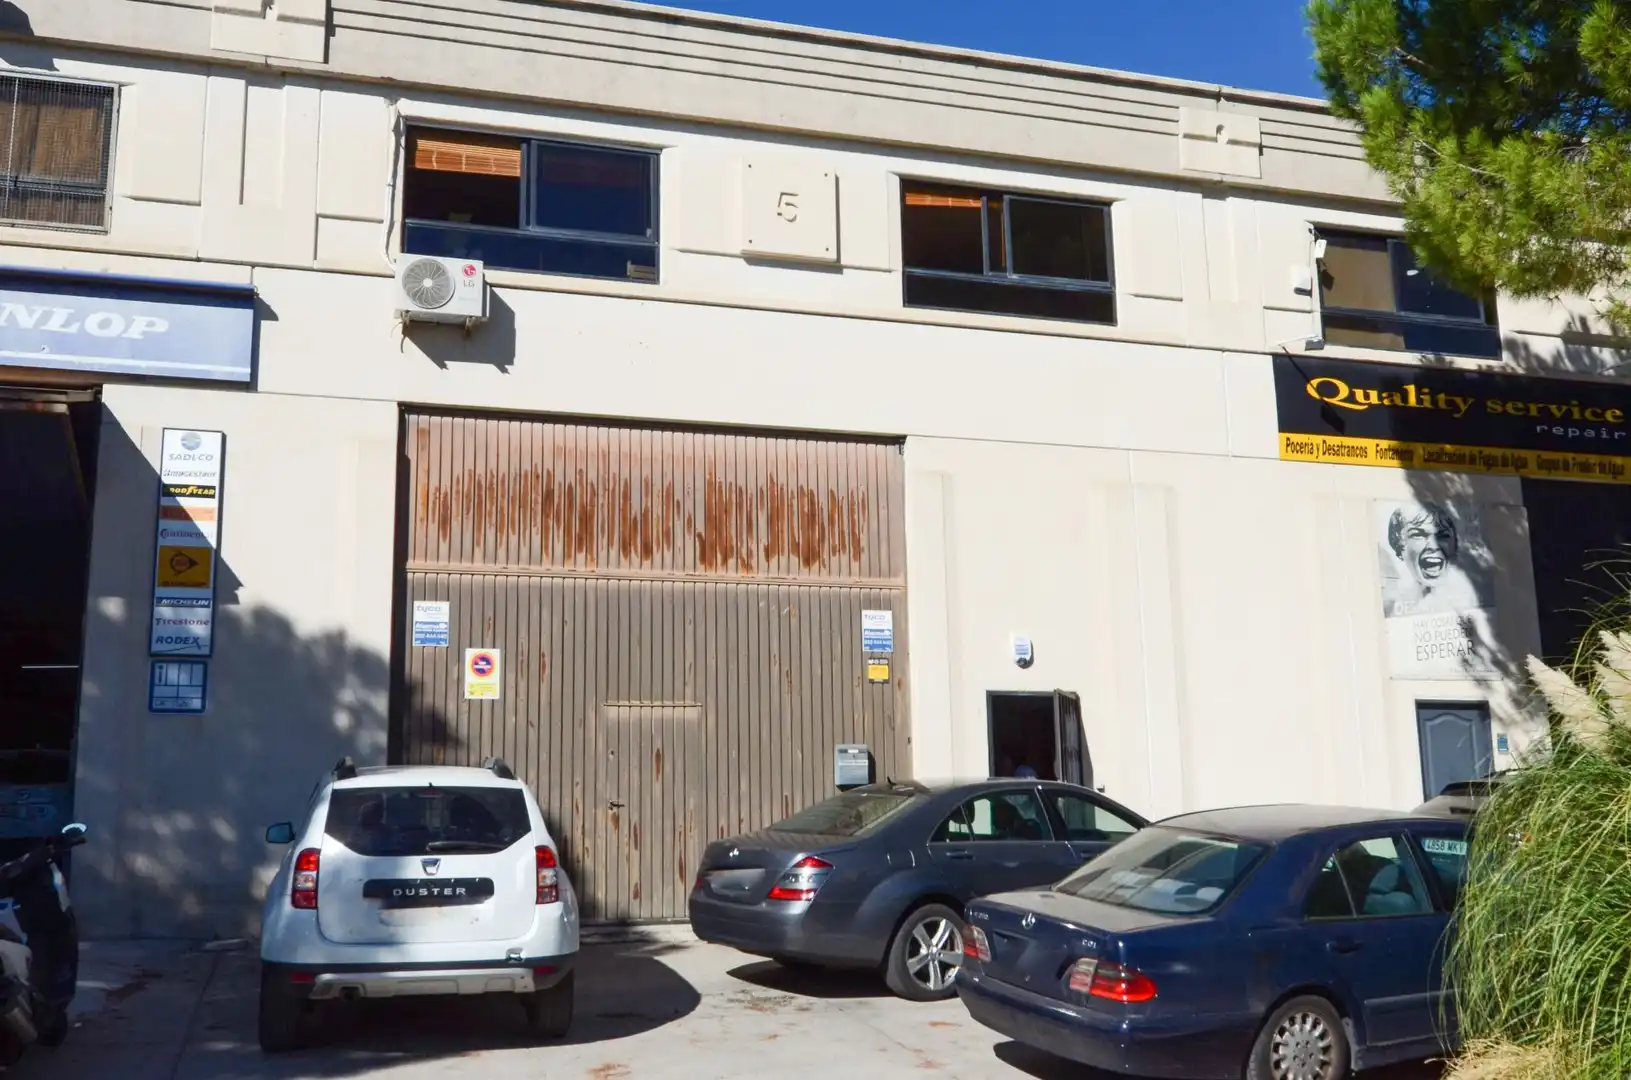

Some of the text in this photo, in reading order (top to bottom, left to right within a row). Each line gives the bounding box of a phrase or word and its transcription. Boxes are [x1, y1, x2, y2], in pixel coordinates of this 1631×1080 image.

[777, 191, 799, 223] 5
[463, 279, 475, 288] LG
[1306, 377, 1625, 424] Quality service
[1536, 425, 1627, 440] repair
[1322, 439, 1369, 459] Desatrancos
[163, 486, 215, 496] OODYEAR
[161, 598, 210, 606] MICHELIN
[155, 617, 210, 626] Firestone
[155, 636, 202, 650] RODEX
[1414, 631, 1432, 643] NO
[1416, 639, 1475, 662] ESPERAR
[392, 887, 467, 897] DUSTER
